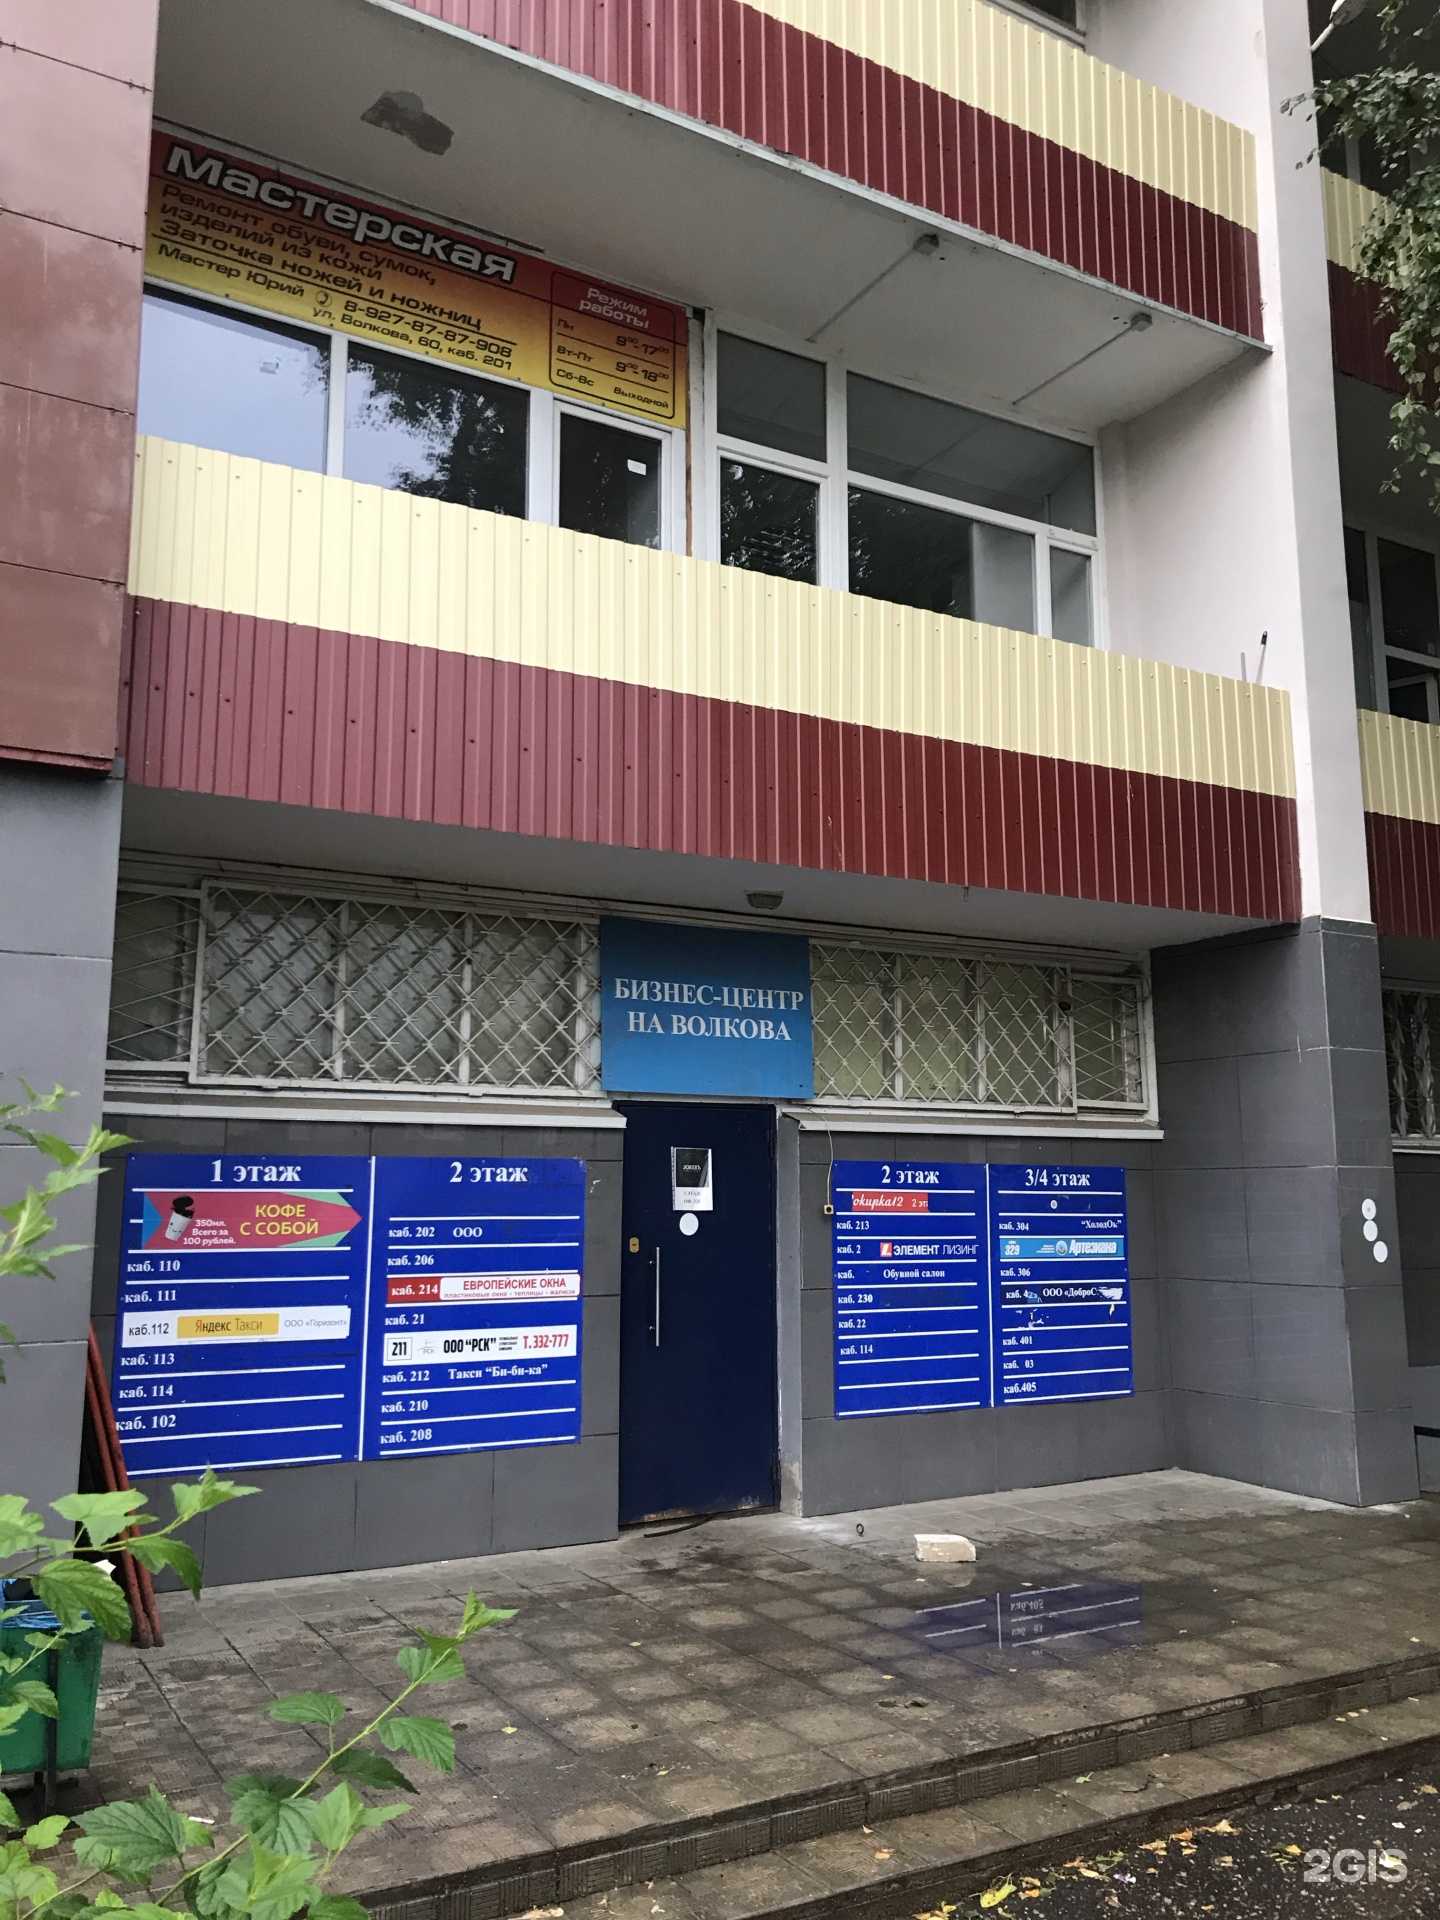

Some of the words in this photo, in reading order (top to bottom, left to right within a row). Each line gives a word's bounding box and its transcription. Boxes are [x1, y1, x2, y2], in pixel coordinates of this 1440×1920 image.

[166, 145, 516, 283] Мастерская
[161, 184, 265, 226] Ремонт
[271, 222, 350, 260] обуви,
[358, 249, 436, 286] сумок,
[160, 204, 275, 248] изделий
[281, 243, 312, 259] из
[319, 253, 383, 282] кожи
[157, 244, 241, 279] Мастер
[247, 270, 305, 297] Юрий
[159, 219, 274, 266] Заточка
[281, 259, 362, 293] ножей
[369, 286, 384, 299] и
[390, 293, 482, 331] ножниц
[586, 287, 648, 317] Режим
[578, 299, 650, 330] работы
[343, 299, 513, 358] 8-927-87-87-908
[312, 307, 336, 321] ул.
[340, 313, 413, 345] Волкова,
[447, 345, 478, 361] каб.
[482, 355, 513, 371] 201
[613, 386, 669, 409] Выходной
[614, 977, 804, 1012] БИЗНЕС-ЦЕНТР
[627, 1010, 665, 1034] НА
[671, 1014, 792, 1041] ВОЛКОВА
[209, 1158, 223, 1183] 1
[232, 1164, 302, 1183] этаж
[449, 1161, 463, 1183] 2
[469, 1166, 529, 1183] этаж
[881, 1165, 891, 1184] 2
[895, 1170, 940, 1184] этаж
[1025, 1168, 1048, 1187] 3/4
[1051, 1172, 1091, 1187] этаж
[255, 1203, 306, 1218] КОФЕ
[191, 1228, 217, 1236] Всего
[239, 1222, 251, 1236] С
[255, 1218, 320, 1236] СОБОЙ
[388, 1227, 413, 1238] каб.
[415, 1226, 435, 1238] 202
[452, 1226, 483, 1238] ООО
[836, 1220, 854, 1230] каб.
[855, 1220, 870, 1230] 213
[998, 1221, 1015, 1231] каб.
[183, 1237, 201, 1245] 100
[837, 1244, 854, 1254] каб.
[893, 1244, 940, 1256] ЭЛЕМЕНТ
[126, 1260, 155, 1273] каб.
[158, 1259, 181, 1272] 110
[387, 1255, 412, 1266] каб.
[414, 1254, 435, 1266] 206
[837, 1270, 855, 1279] каб.
[883, 1268, 920, 1281] Обувной
[921, 1269, 946, 1278] салон
[1000, 1268, 1016, 1278] каб.
[391, 1285, 416, 1296] каб.
[419, 1284, 438, 1295] 214
[463, 1277, 537, 1291] ЕВРОПЕЙСКИЕ
[539, 1277, 567, 1289] ОКНА
[1005, 1290, 1022, 1299] каб.
[1042, 1287, 1063, 1297] ООО
[124, 1291, 153, 1303] каб.
[156, 1289, 177, 1302] 111
[838, 1294, 855, 1304] каб.
[857, 1293, 873, 1303] 230
[194, 1318, 232, 1333] Яндекс
[234, 1317, 263, 1331] Такси
[384, 1314, 409, 1326] каб.
[838, 1319, 856, 1329] каб.
[128, 1322, 170, 1336] каб.112
[391, 1341, 407, 1356] 211
[443, 1339, 464, 1354] ООО
[1002, 1336, 1019, 1346] каб.
[840, 1345, 858, 1355] каб.
[859, 1344, 873, 1354] 114
[120, 1354, 149, 1366] каб.
[152, 1353, 175, 1365] 113
[1003, 1360, 1020, 1369] каб.
[382, 1371, 407, 1383] каб.
[409, 1370, 430, 1382] 212
[447, 1367, 483, 1380] Такси
[119, 1386, 147, 1398] каб.
[151, 1384, 174, 1397] 114
[381, 1401, 406, 1413] каб.
[409, 1400, 429, 1412] 210
[115, 1416, 147, 1431] каб.
[151, 1414, 177, 1429] 102
[380, 1431, 407, 1444] каб.
[410, 1429, 433, 1442] 208
